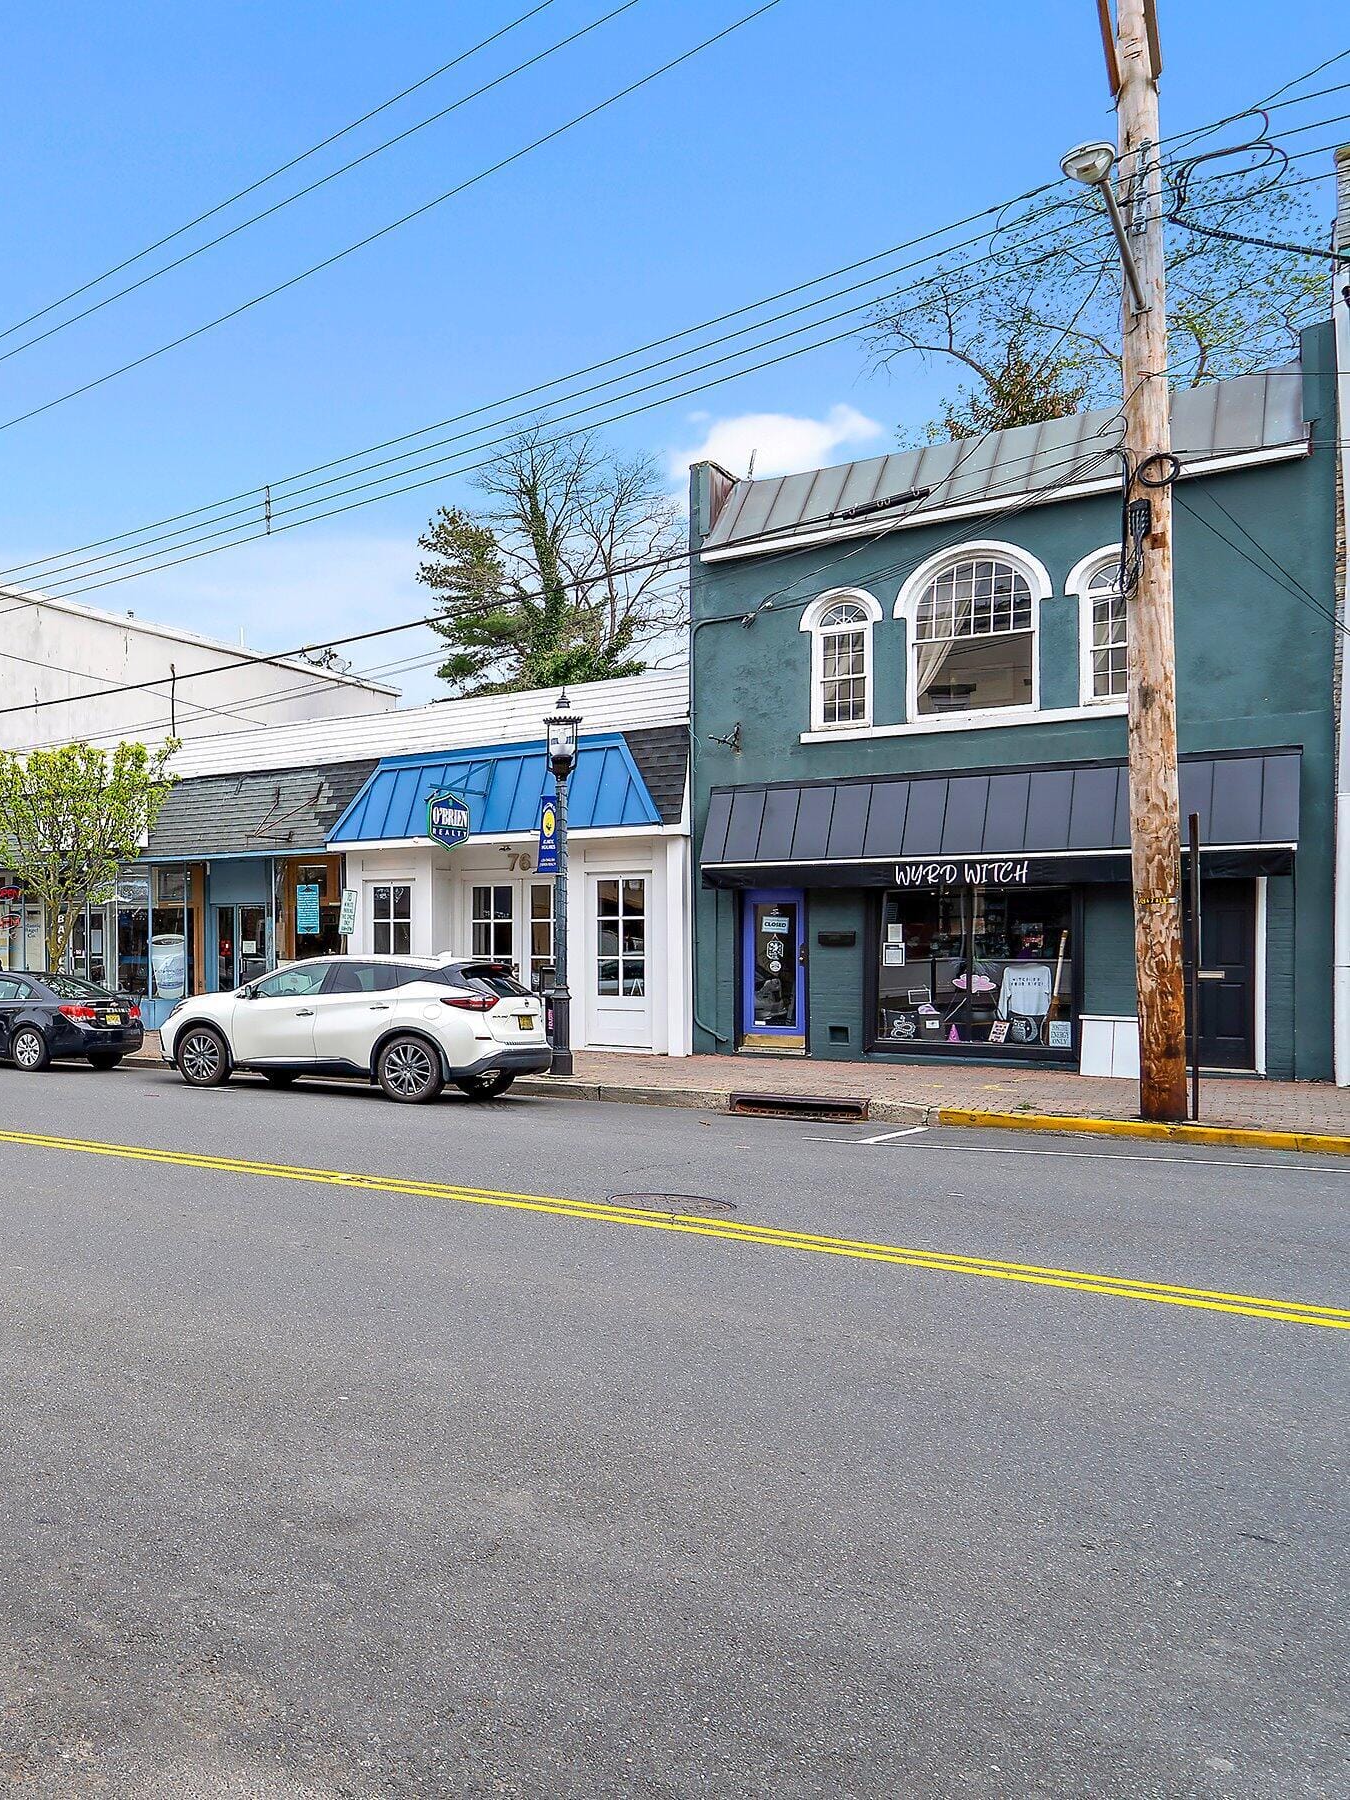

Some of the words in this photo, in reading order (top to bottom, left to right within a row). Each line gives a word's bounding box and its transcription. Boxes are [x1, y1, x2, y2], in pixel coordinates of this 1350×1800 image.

[432, 806, 468, 828] O'BRIEN
[432, 827, 468, 838] REALTY
[507, 852, 532, 872] 76
[894, 863, 958, 886] WYRD
[963, 860, 1029, 885] WITCH
